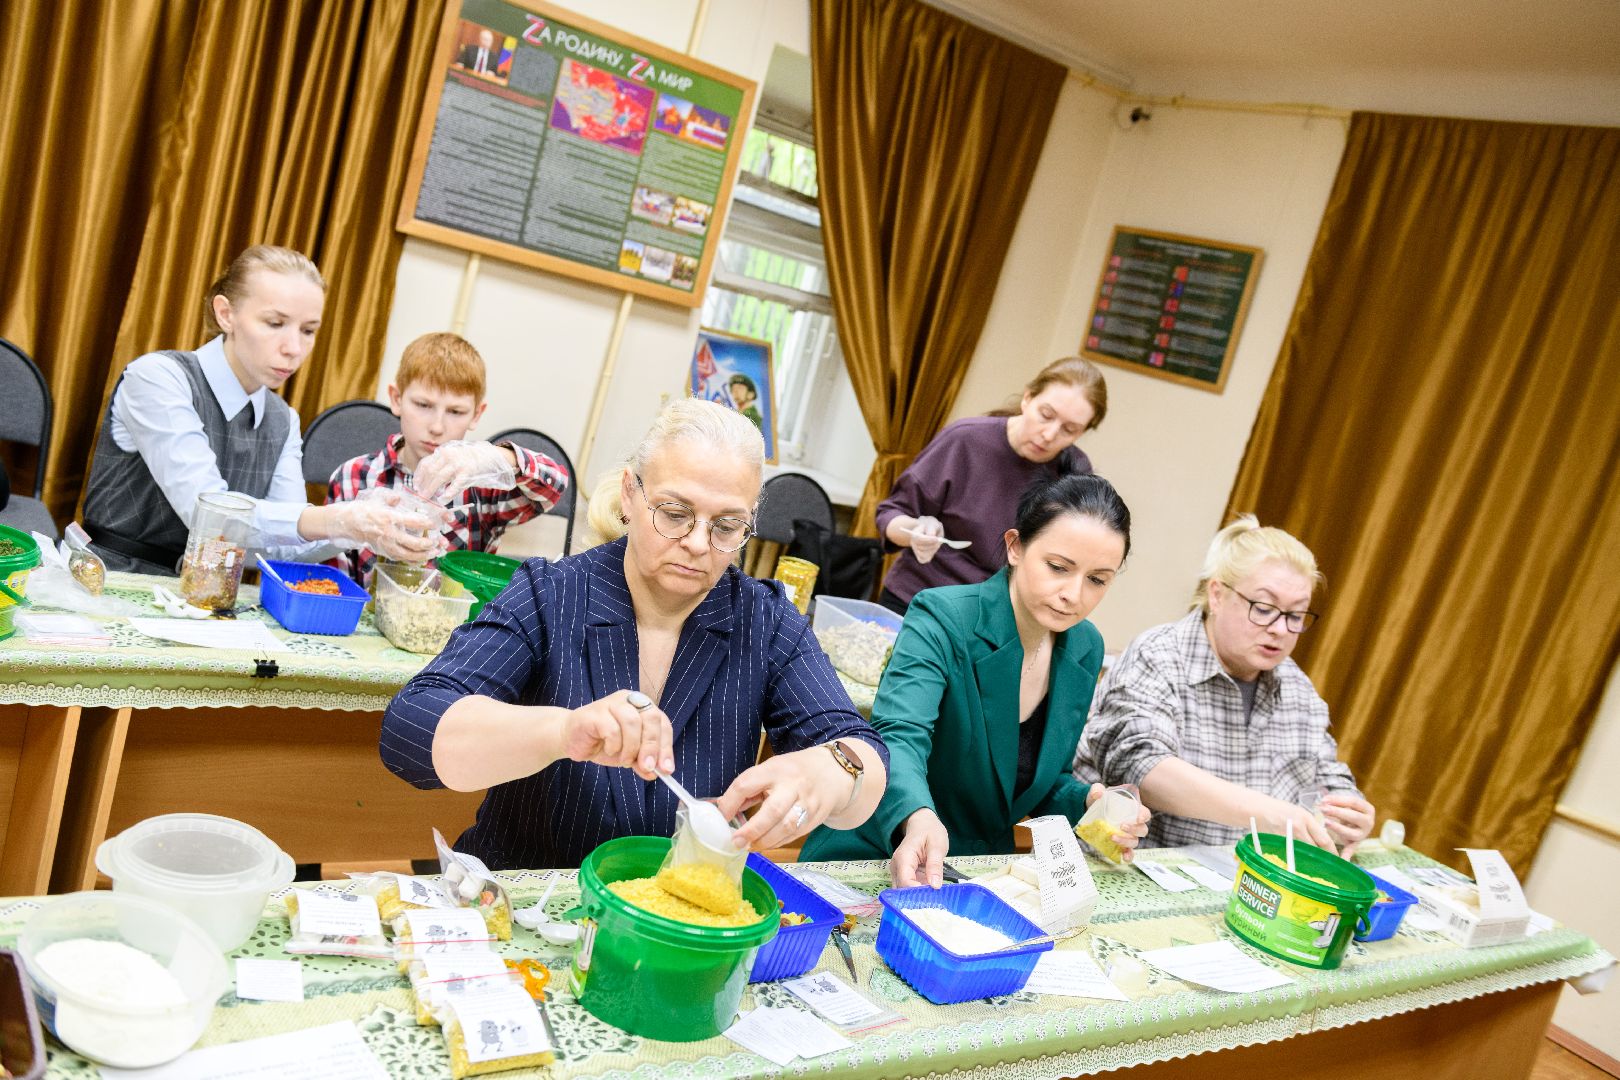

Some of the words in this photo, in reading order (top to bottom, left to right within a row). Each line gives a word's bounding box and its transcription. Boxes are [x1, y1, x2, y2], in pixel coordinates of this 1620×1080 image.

[658, 70, 693, 91] МИР
[1238, 887, 1274, 917] SERVICE
[1242, 874, 1277, 904] DINNER
